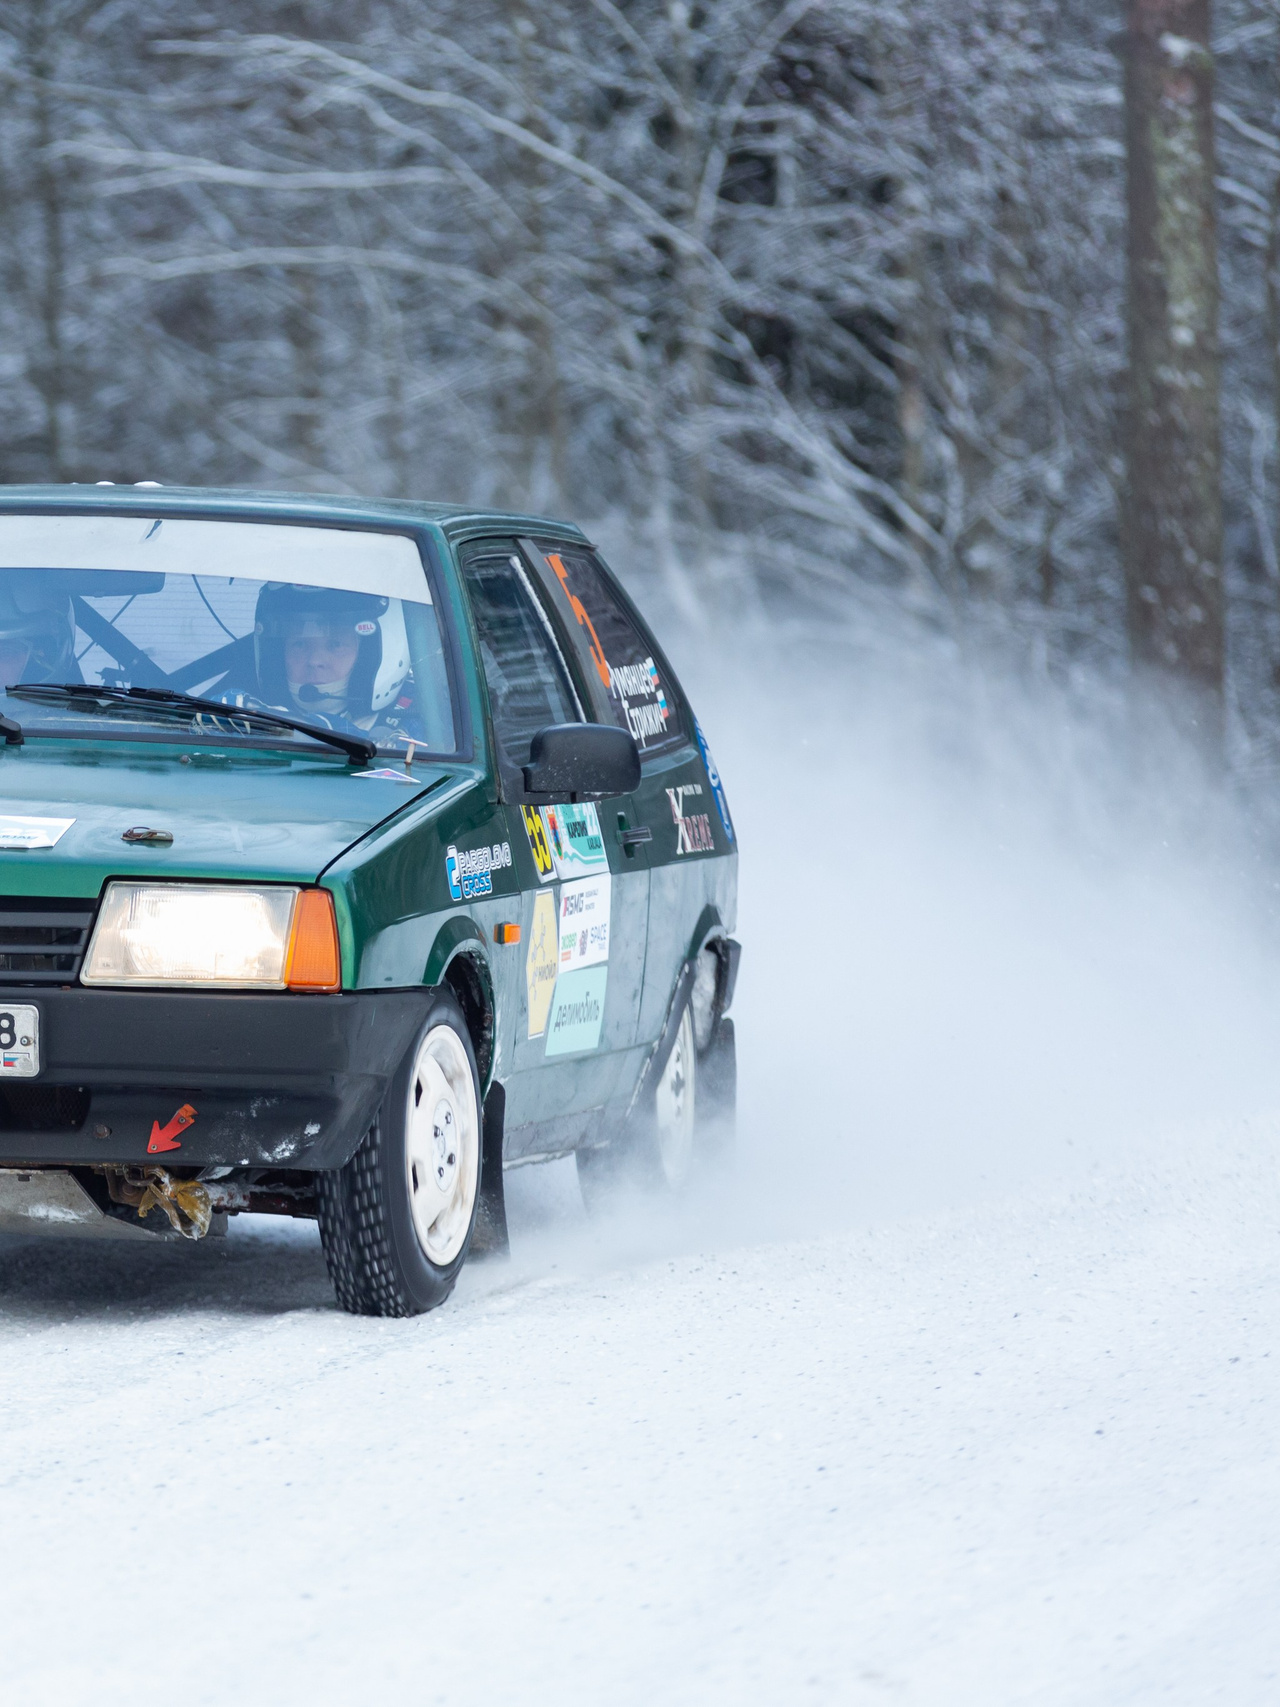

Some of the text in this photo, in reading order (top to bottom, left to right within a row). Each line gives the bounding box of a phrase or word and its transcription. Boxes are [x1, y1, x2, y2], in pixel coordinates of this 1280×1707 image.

[522, 805, 552, 873] 55
[458, 842, 512, 874] PARGOLOVO
[462, 870, 492, 899] CROSS
